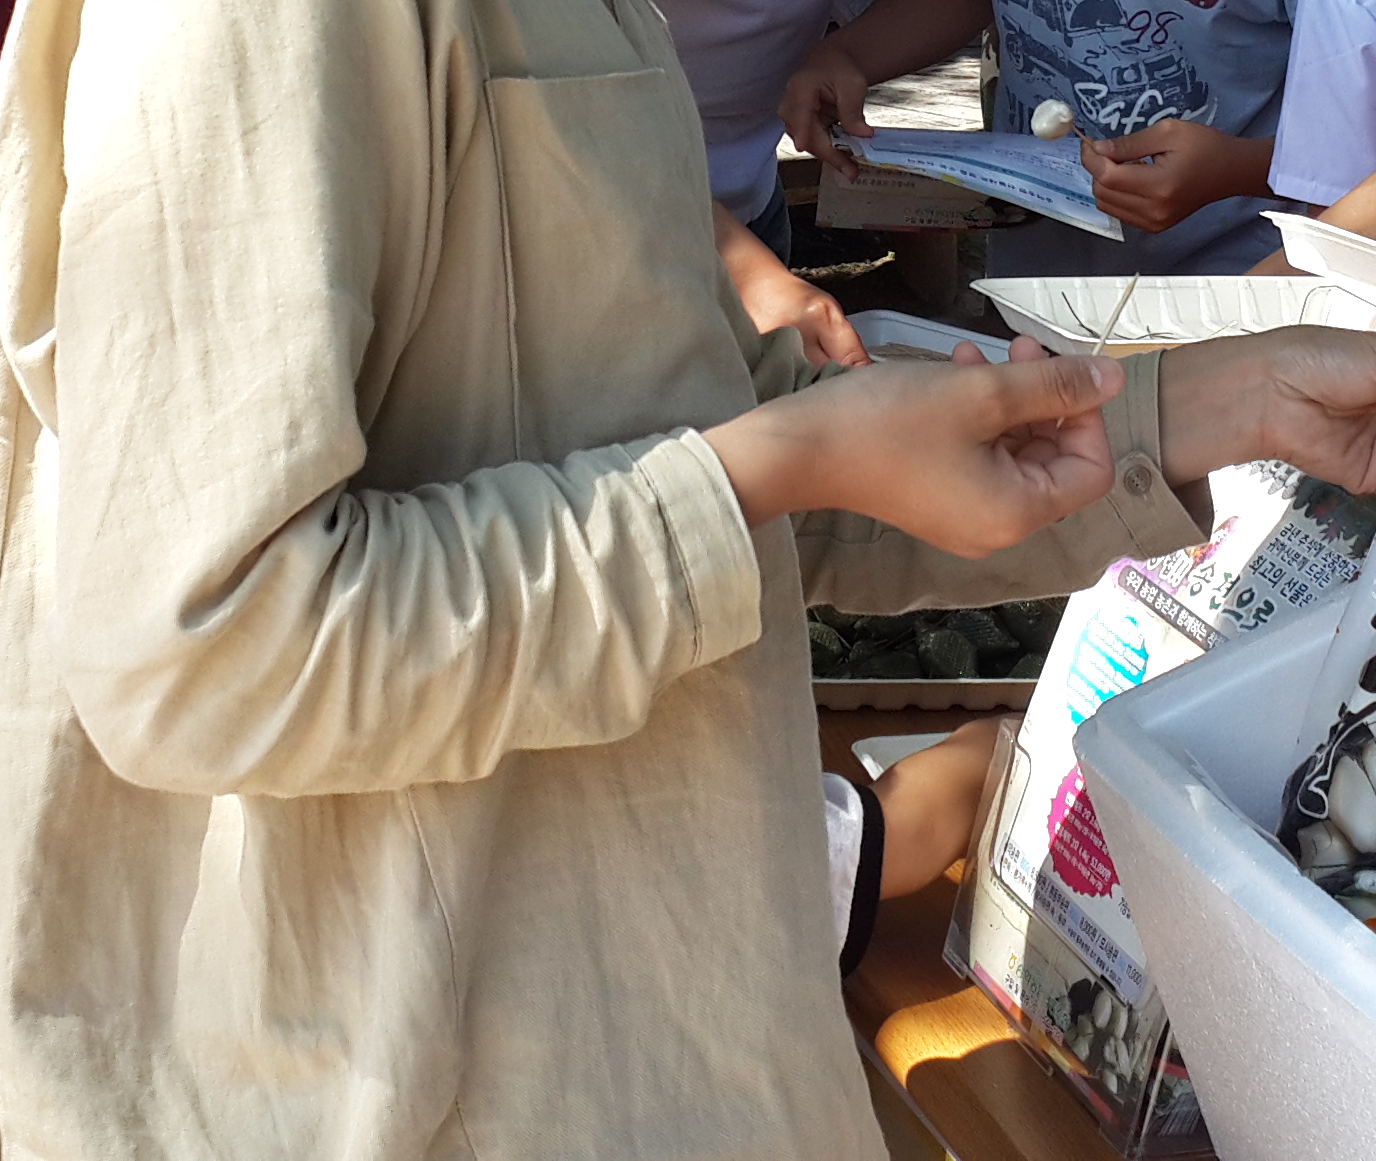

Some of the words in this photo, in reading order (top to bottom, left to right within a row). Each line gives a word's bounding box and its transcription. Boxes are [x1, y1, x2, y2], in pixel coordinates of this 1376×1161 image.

[1248, 554, 1286, 588] 최고의
[1266, 537, 1310, 572] 귀하신분께
[1305, 563, 1330, 588] 드리는
[1280, 522, 1302, 542] 금년
[1298, 533, 1326, 558] 추석에
[1321, 550, 1358, 578] 소중하고
[1125, 570, 1143, 593] 우리
[1139, 581, 1158, 604] 농업
[1154, 592, 1180, 620] 농촌과
[1176, 609, 1208, 642] 함께하는
